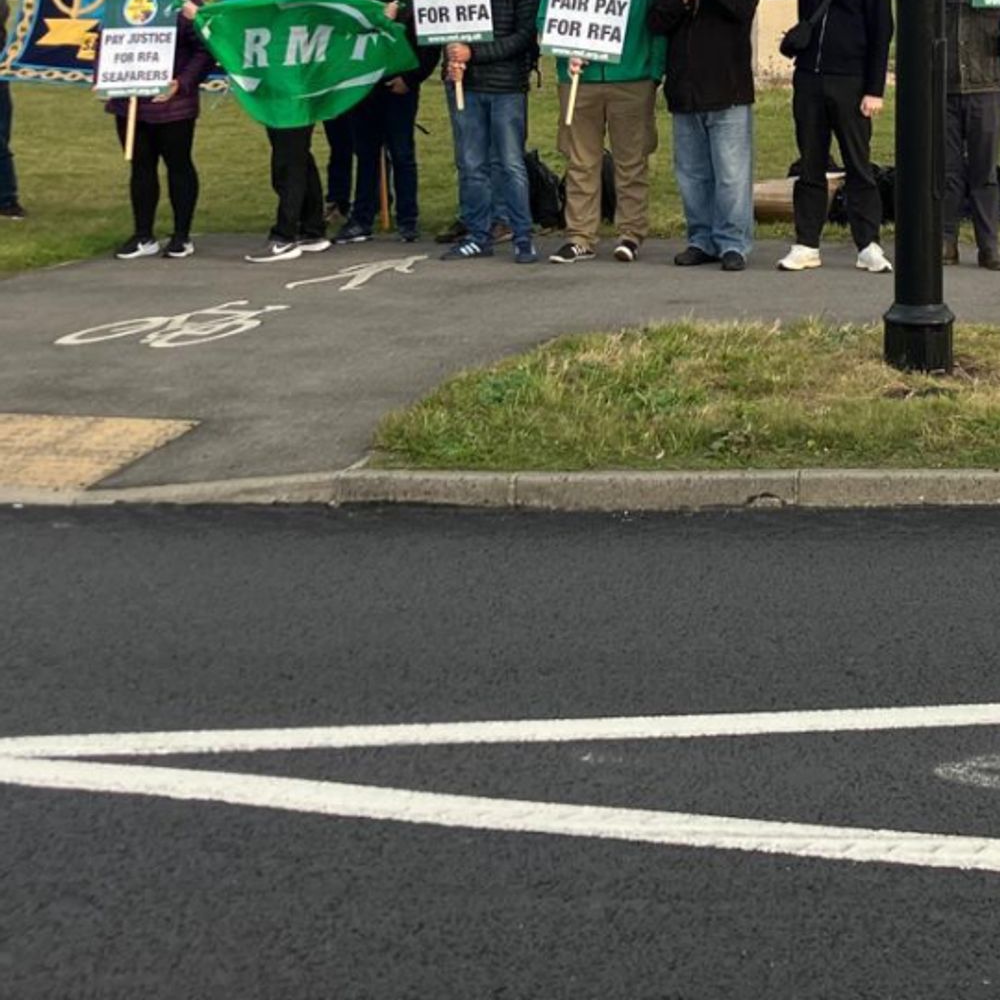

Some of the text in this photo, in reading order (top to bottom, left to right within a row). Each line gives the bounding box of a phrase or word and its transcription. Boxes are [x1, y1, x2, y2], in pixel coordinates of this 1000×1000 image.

[417, 4, 490, 24] FOR RFA
[104, 34, 125, 45] PAY
[127, 32, 172, 44] JUSTICE
[546, 18, 622, 43] FOR RFA
[243, 24, 378, 69] RMT
[114, 51, 159, 63] FOR RFA
[101, 70, 169, 83] SEAFARERS
